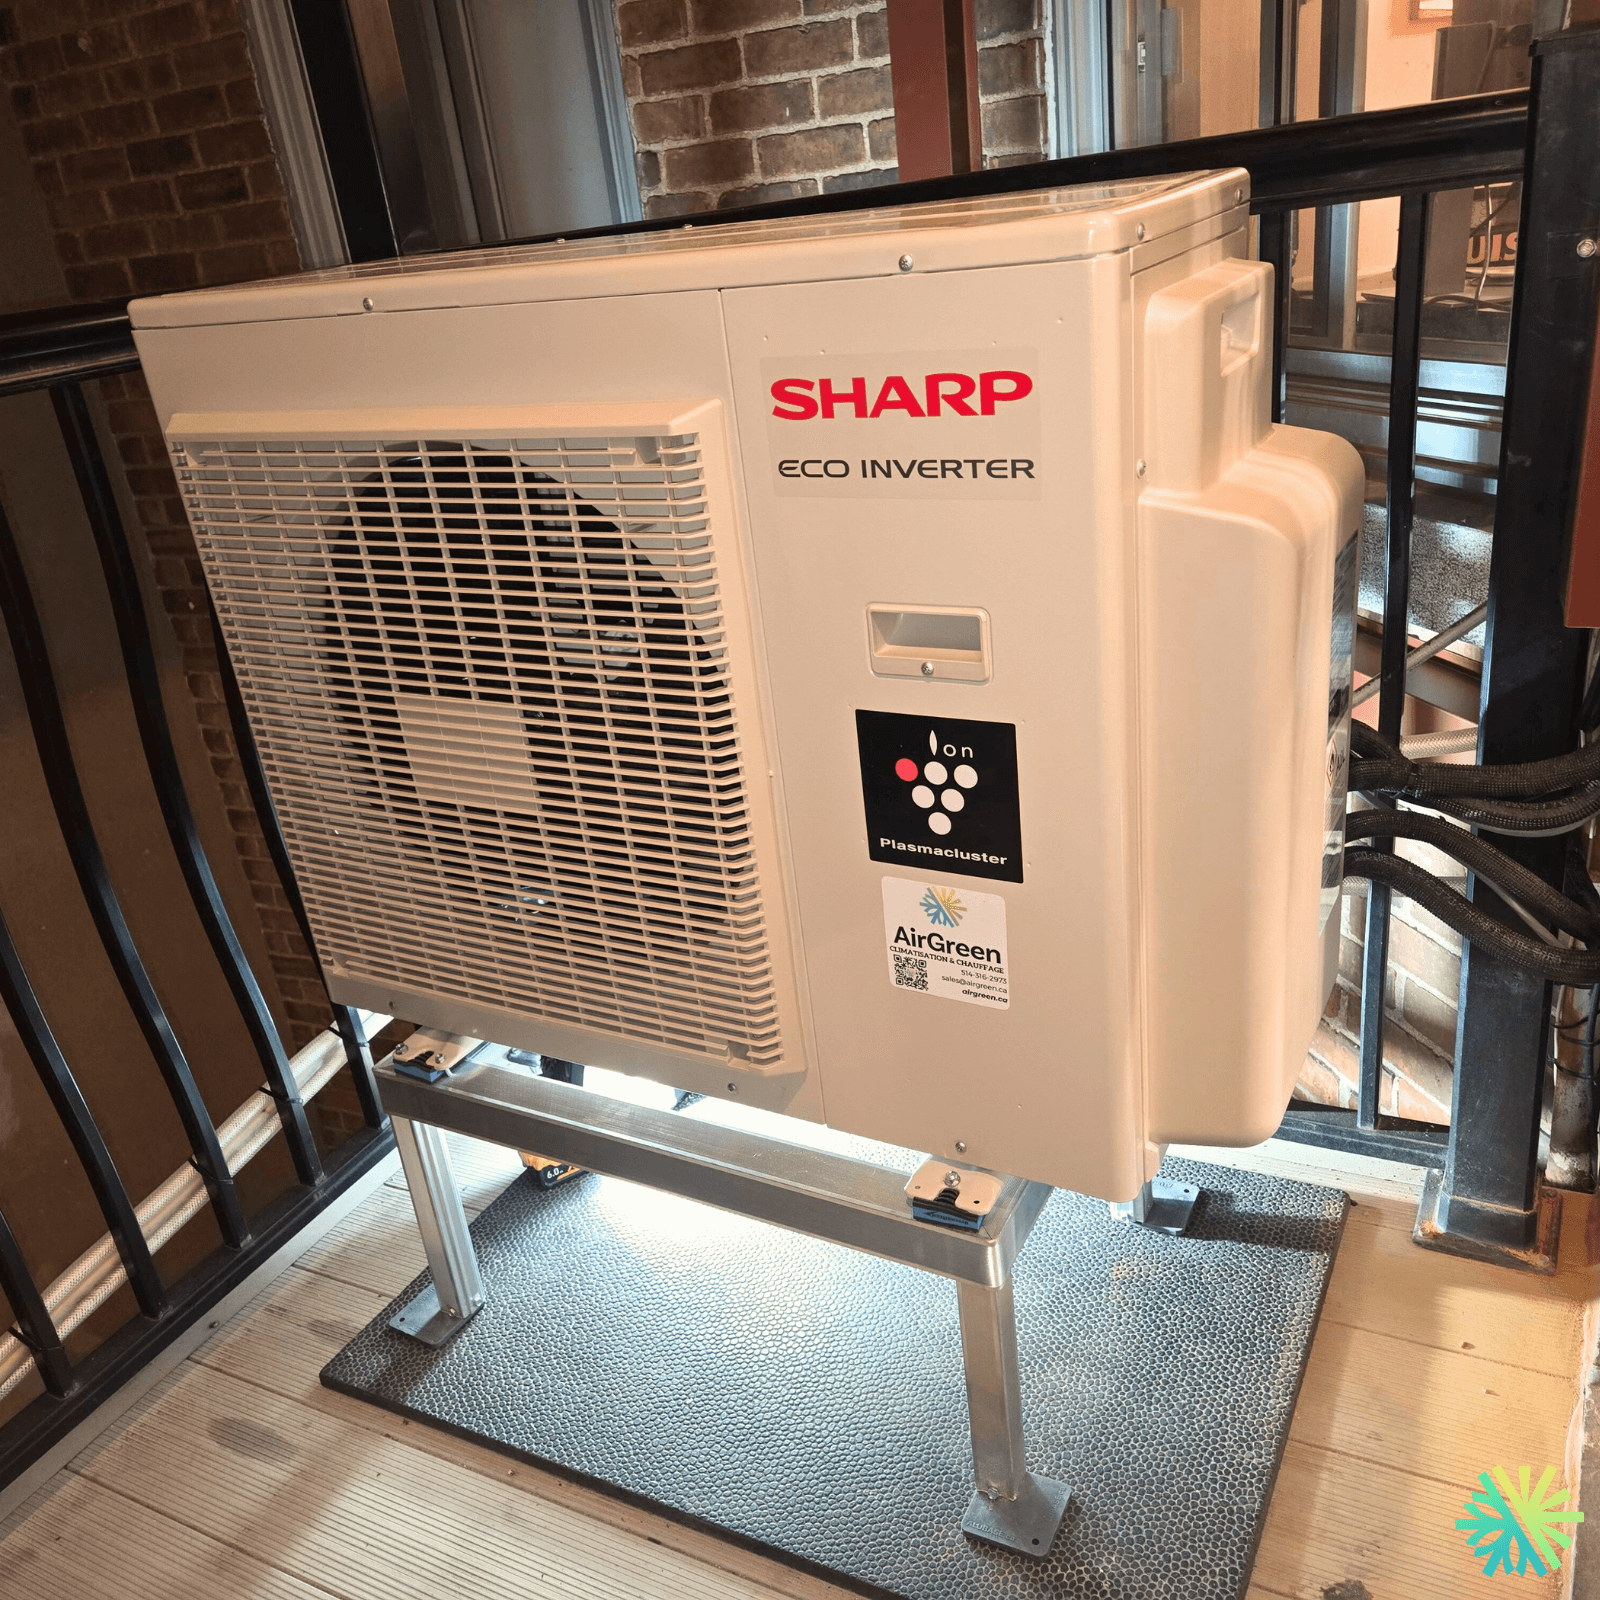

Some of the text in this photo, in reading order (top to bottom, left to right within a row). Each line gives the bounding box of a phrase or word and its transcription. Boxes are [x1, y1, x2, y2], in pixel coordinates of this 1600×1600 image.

[770, 370, 1033, 421] SHARP
[778, 459, 1035, 479] ECO INVERTER
[929, 729, 974, 759] Ion
[879, 837, 1008, 865] Plasmacluster
[893, 925, 1002, 964] AirGreen
[889, 945, 949, 963] CLIMATISATION
[956, 959, 1005, 974] CHAUFFAGE
[941, 975, 1008, 994] sales@airgreen.ca
[960, 969, 1008, 985] 514-316-2973
[961, 989, 1009, 1003] airgreen.ca
